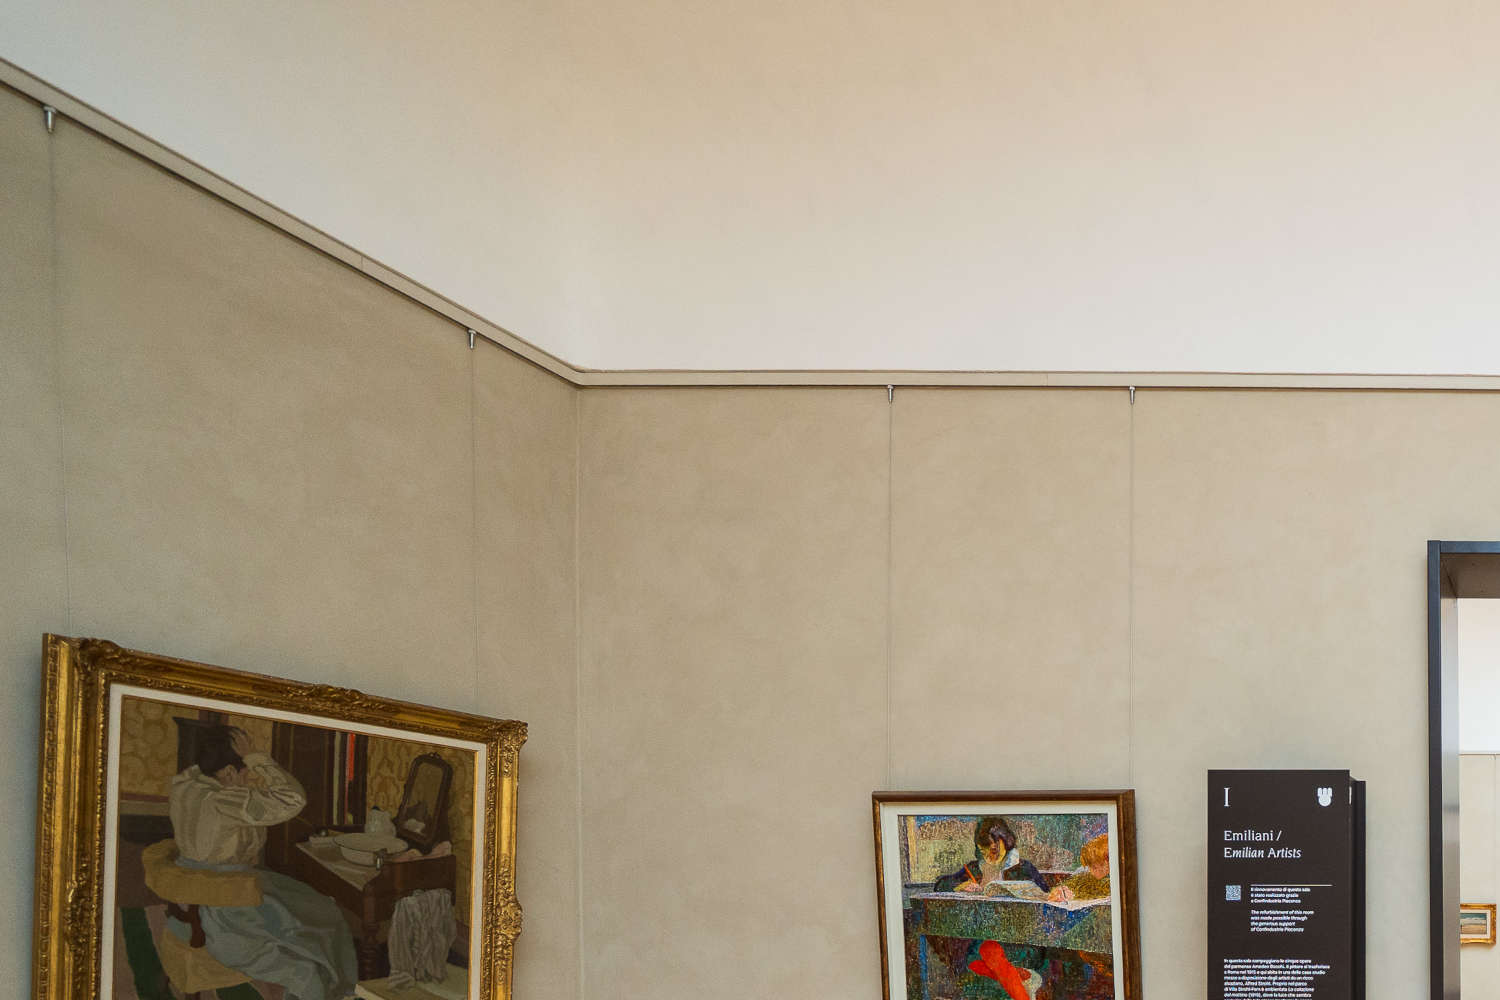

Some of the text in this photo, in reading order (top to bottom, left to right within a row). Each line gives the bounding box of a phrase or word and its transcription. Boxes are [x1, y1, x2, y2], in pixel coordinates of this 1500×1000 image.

[1224, 830, 1274, 841] Emiliani
[1224, 847, 1302, 858] Emilian Artists
